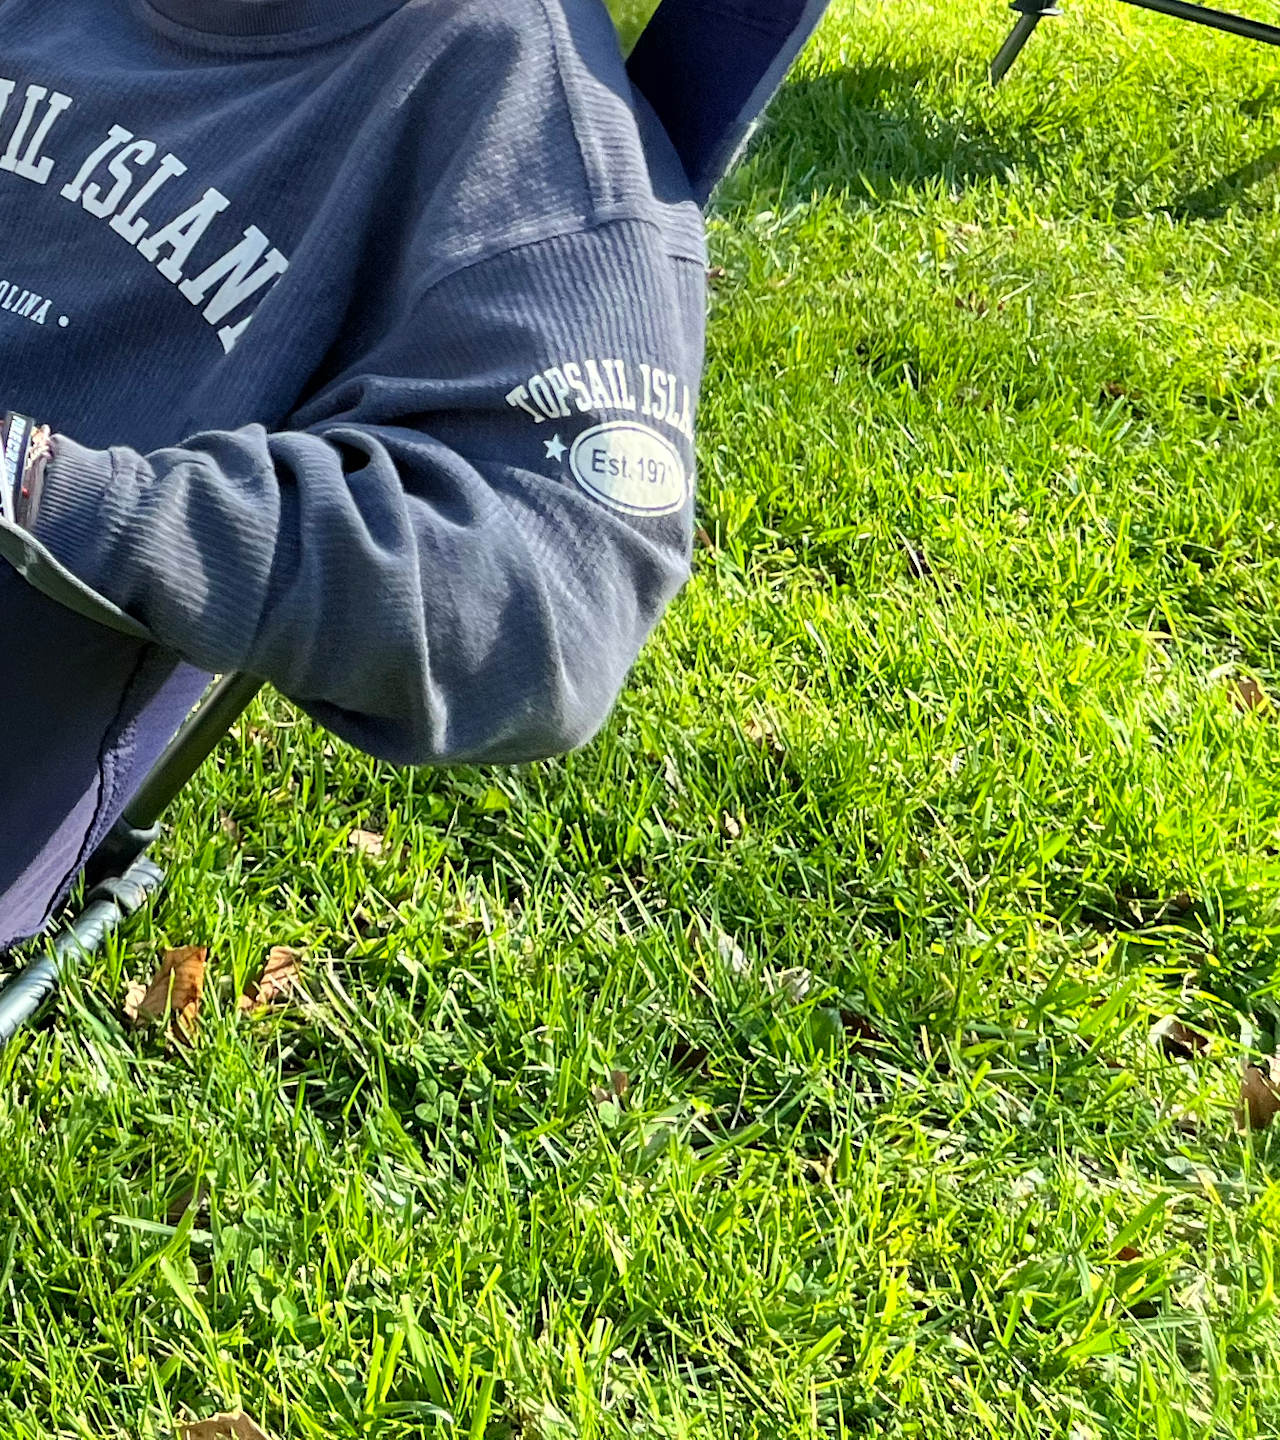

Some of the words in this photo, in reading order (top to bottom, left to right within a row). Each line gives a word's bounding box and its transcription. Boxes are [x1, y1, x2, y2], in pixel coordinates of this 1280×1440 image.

[60, 124, 290, 355] ISLAN
[505, 359, 636, 424] TOPSAIL
[591, 448, 632, 479] Est.
